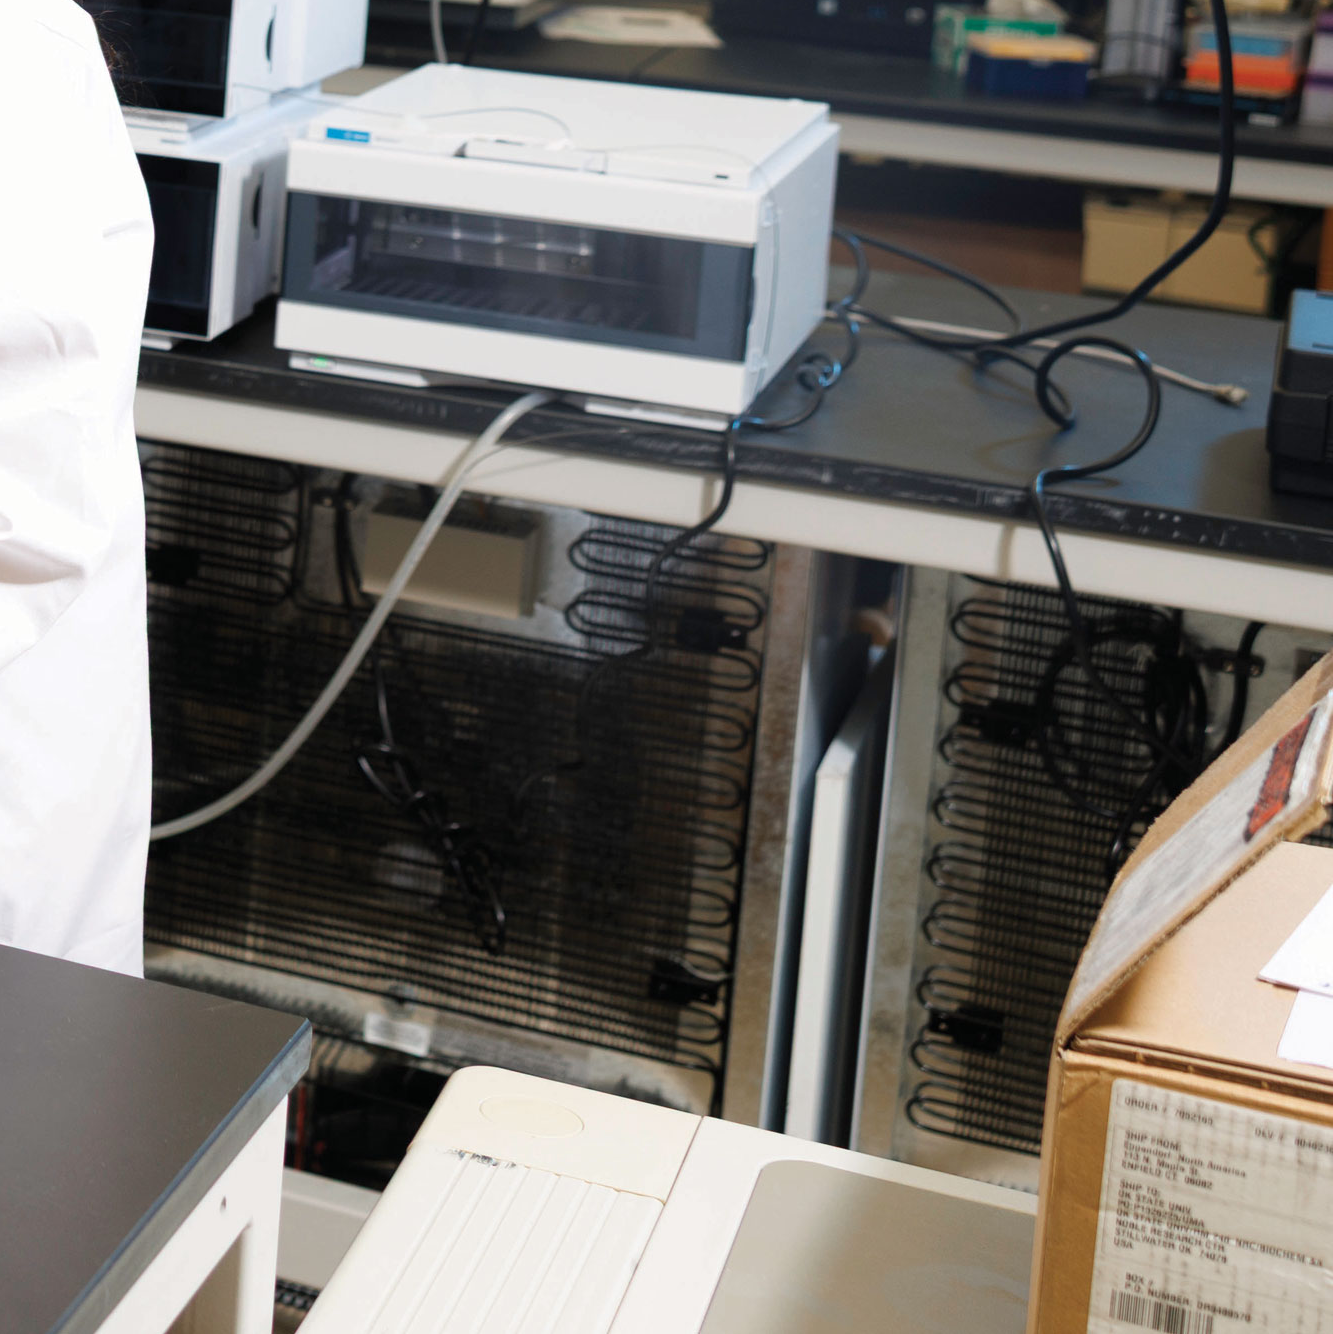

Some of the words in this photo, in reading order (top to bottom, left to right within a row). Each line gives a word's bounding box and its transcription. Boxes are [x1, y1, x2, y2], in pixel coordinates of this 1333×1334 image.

[1125, 1129, 1148, 1143] SHIP
[1120, 1179, 1143, 1192] SHIP
[1135, 1194, 1165, 1208] STATE
[1134, 1212, 1164, 1227] STATE
[1114, 1227, 1176, 1251] STILLWATER
[1115, 1218, 1146, 1233] NOBLE
[1150, 1224, 1203, 1246] RESEARCH
[1113, 1238, 1134, 1250] USA
[1125, 1272, 1145, 1285] BOX
